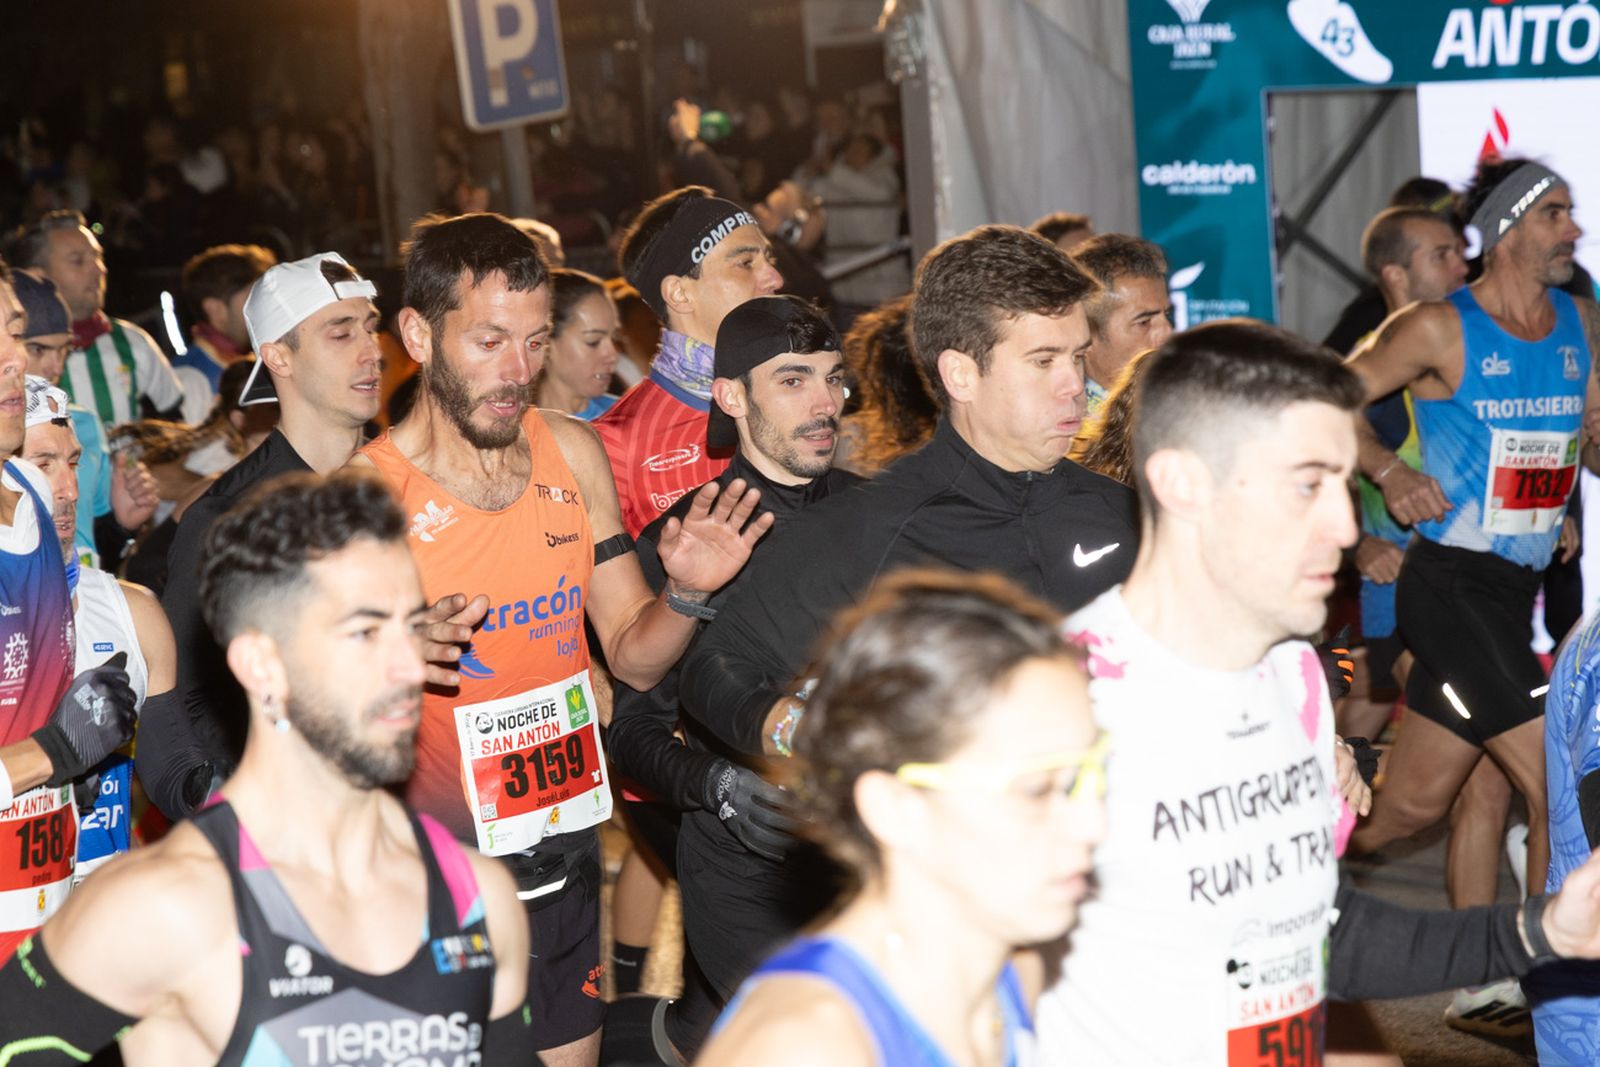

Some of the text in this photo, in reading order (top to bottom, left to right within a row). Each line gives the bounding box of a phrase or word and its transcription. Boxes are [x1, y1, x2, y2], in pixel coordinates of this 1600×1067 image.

[478, 0, 538, 107] P
[1320, 18, 1355, 58] 43
[1142, 159, 1256, 186] calderón
[534, 484, 579, 505] TRACK
[1515, 469, 1566, 500] 7132
[497, 708, 539, 732] NOCHE
[541, 702, 557, 720] DE
[481, 734, 513, 756] SAN
[517, 720, 560, 748] ANTÓN
[501, 734, 585, 799] 3159
[22, 789, 54, 817] ANTÓN
[16, 813, 64, 870] 158
[1188, 853, 1252, 906] RUN
[1265, 843, 1283, 883] &
[269, 976, 333, 998] VIATOR
